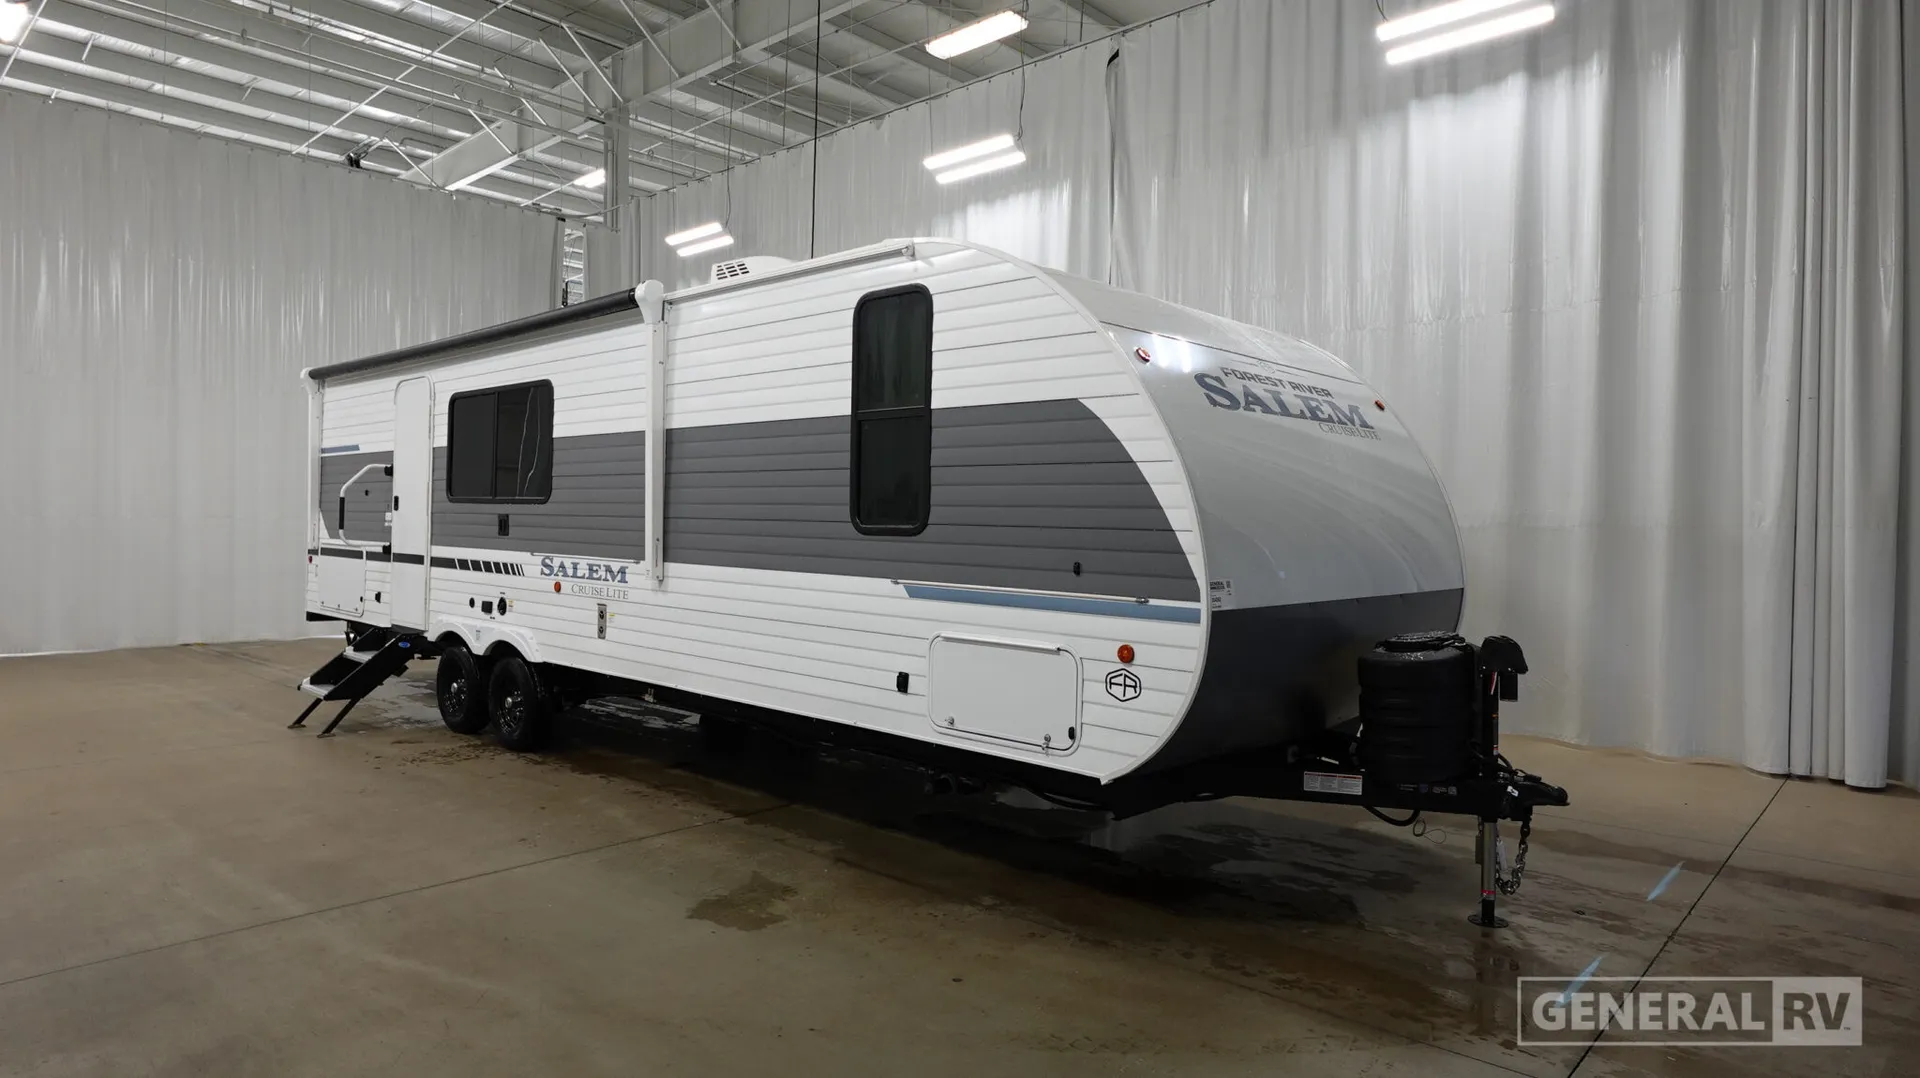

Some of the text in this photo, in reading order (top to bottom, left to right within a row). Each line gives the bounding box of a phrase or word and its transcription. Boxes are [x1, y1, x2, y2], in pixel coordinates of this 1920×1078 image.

[1219, 366, 1334, 399] FOREST RIVER
[1193, 372, 1375, 430] SALEM
[541, 556, 628, 583] SALEM
